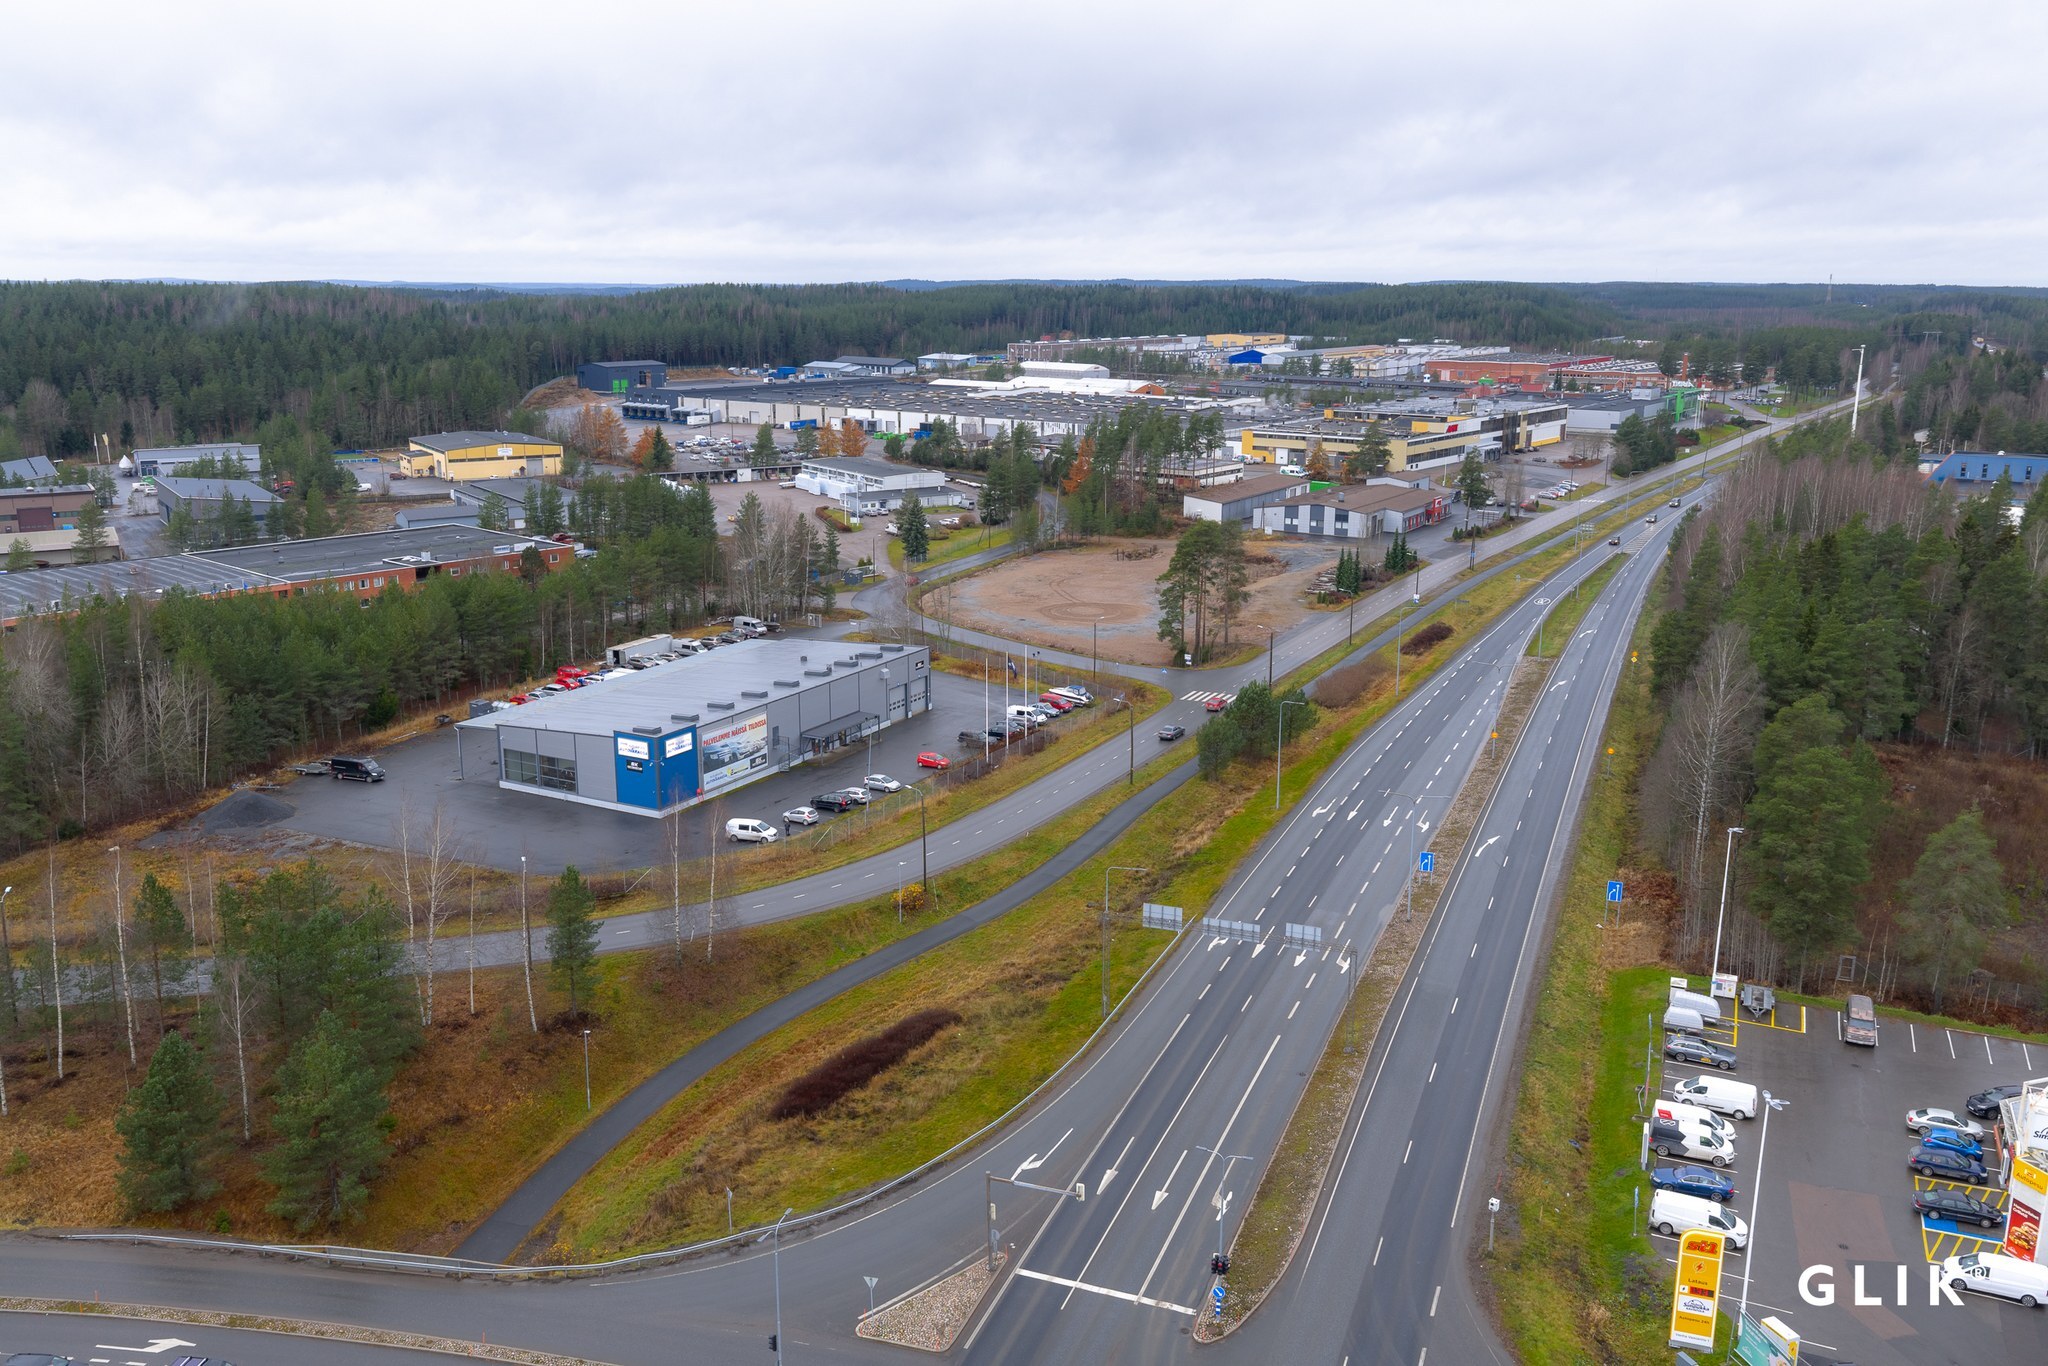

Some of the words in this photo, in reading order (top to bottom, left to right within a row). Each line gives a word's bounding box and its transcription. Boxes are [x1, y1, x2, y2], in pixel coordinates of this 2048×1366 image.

[2016, 1172, 2043, 1190] Autopesu
[1688, 1278, 1708, 1286] Lataus
[1679, 1315, 1700, 1323] Autopesu
